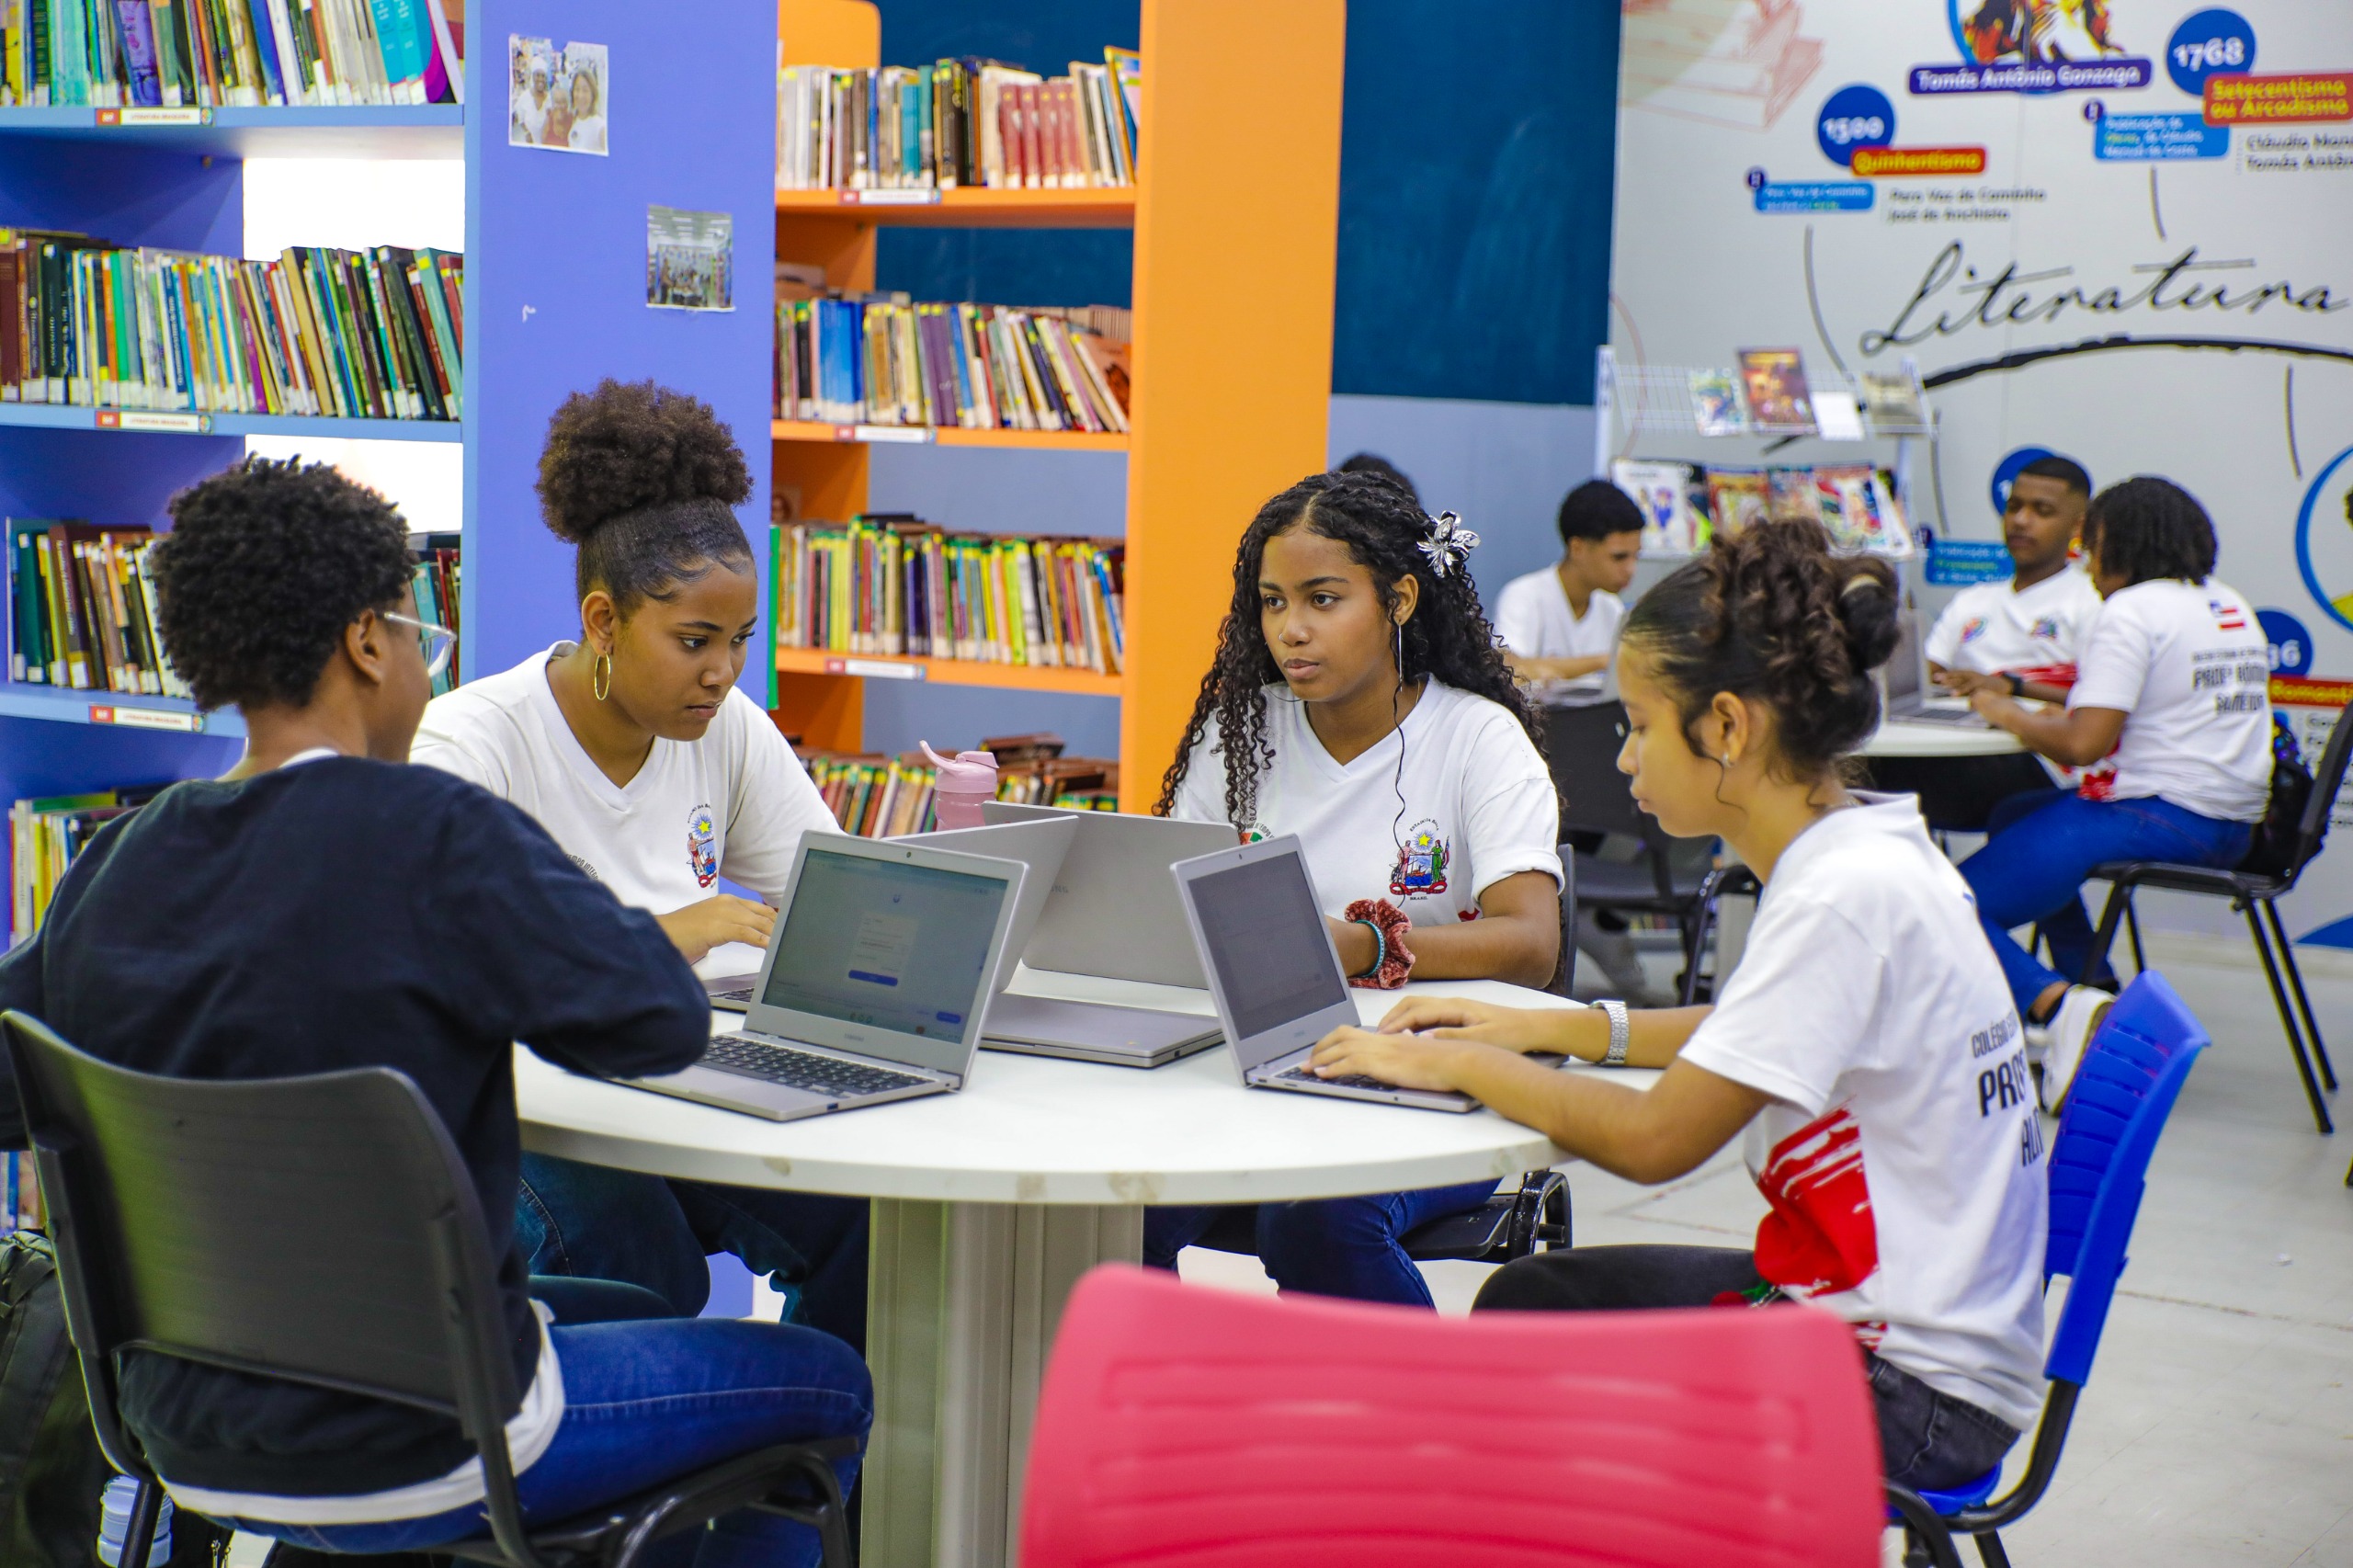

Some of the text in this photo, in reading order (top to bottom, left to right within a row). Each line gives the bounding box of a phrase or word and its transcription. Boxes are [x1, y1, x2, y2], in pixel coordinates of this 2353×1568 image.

[2172, 37, 2245, 72] 1768
[1917, 65, 2141, 90] Tomás Antônio Gonzaga
[2212, 76, 2347, 99] Setecentismo
[2210, 97, 2349, 119] ou Arcadismo
[1822, 116, 1886, 145] 1500
[1854, 151, 1982, 174] Quinhentismo
[1859, 239, 2349, 355] Literatura
[1971, 1019, 2009, 1059] COLÉGIO
